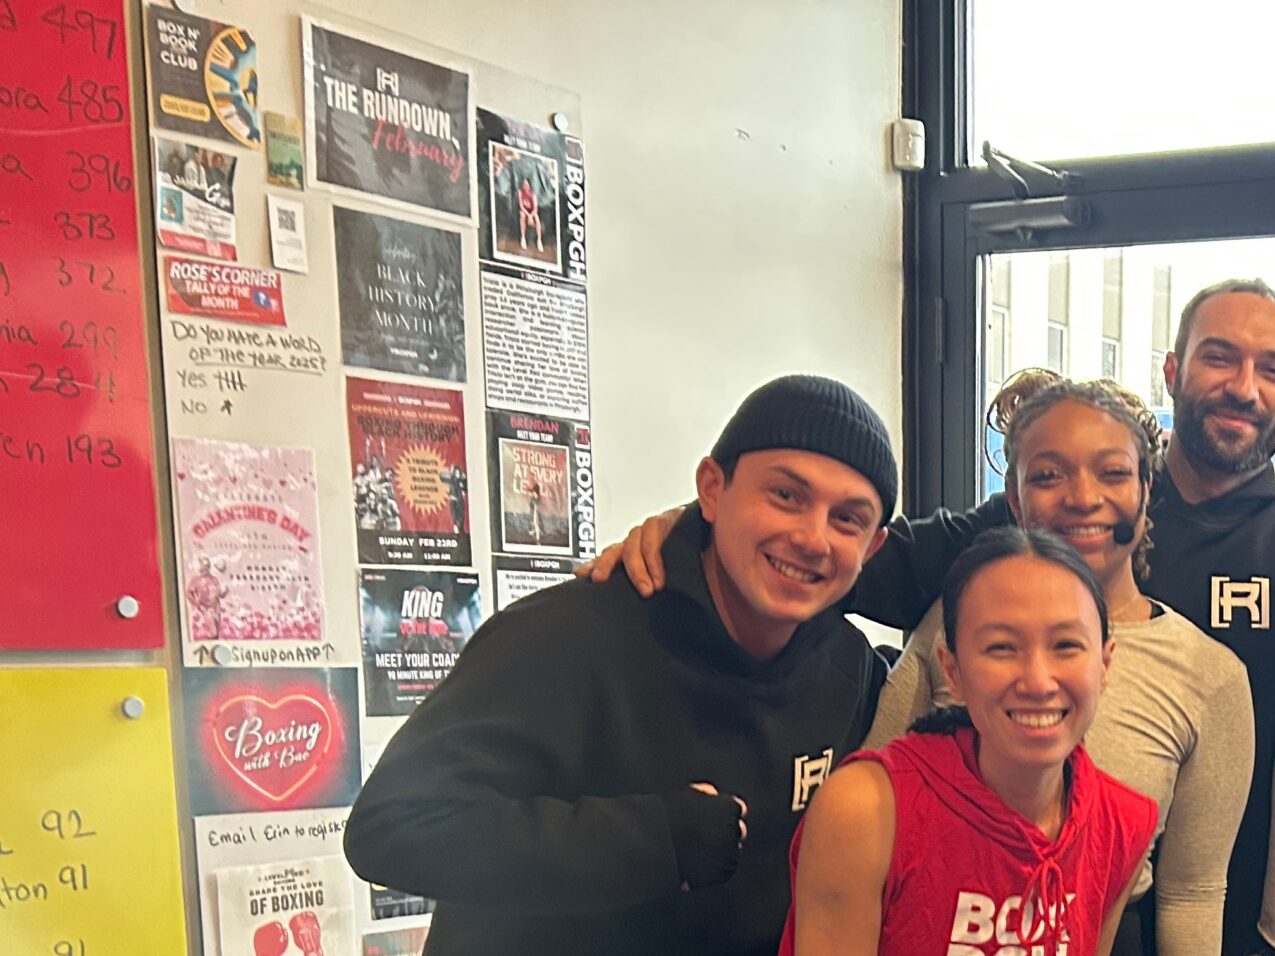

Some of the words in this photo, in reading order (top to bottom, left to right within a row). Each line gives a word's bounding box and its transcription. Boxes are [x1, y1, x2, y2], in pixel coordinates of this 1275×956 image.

[41, 3, 117, 59] 497
[157, 19, 185, 37] BOX
[159, 32, 197, 52] BOOK
[160, 50, 198, 70] CLUB
[57, 74, 124, 122] 485
[322, 76, 358, 113] THE
[363, 88, 451, 141] RUNDOWN
[371, 119, 465, 184] February
[66, 151, 132, 193] 396
[54, 211, 115, 241] 373
[565, 162, 586, 282] BOXPGH
[50, 256, 126, 294] 372
[170, 261, 220, 281] ROSE'S
[221, 268, 277, 288] CORNER
[377, 263, 427, 288] BLACK
[185, 280, 216, 294] TALLY
[217, 284, 230, 296] OF
[232, 286, 250, 298] THE
[369, 285, 434, 312] HISTORY
[201, 296, 238, 310] MONTH
[375, 309, 432, 335] MONTH
[60, 320, 118, 360] 299
[266, 333, 277, 346] A
[26, 363, 116, 405] 284
[510, 415, 559, 434] BRENDAN
[67, 434, 122, 468] 193
[513, 447, 556, 468] STRONG
[513, 463, 528, 478] AT
[575, 451, 597, 559] BOXPGH
[279, 515, 311, 542] DAY
[379, 536, 414, 548] SUNDAY
[419, 538, 435, 548] FEB
[437, 539, 458, 548] 23RD
[401, 590, 444, 618] KING
[376, 653, 402, 668] MEET
[405, 653, 430, 667] YOUR
[224, 716, 321, 760] Boxing
[244, 753, 271, 771] with
[41, 809, 96, 840] 92
[208, 827, 257, 847] Email
[264, 825, 290, 842] Erin
[295, 824, 305, 837] to
[58, 863, 88, 891] 91
[249, 886, 277, 897] SHARE
[281, 884, 298, 892] THE
[301, 880, 323, 889] LOVE
[250, 897, 267, 916] OF
[271, 890, 324, 913] BOXING
